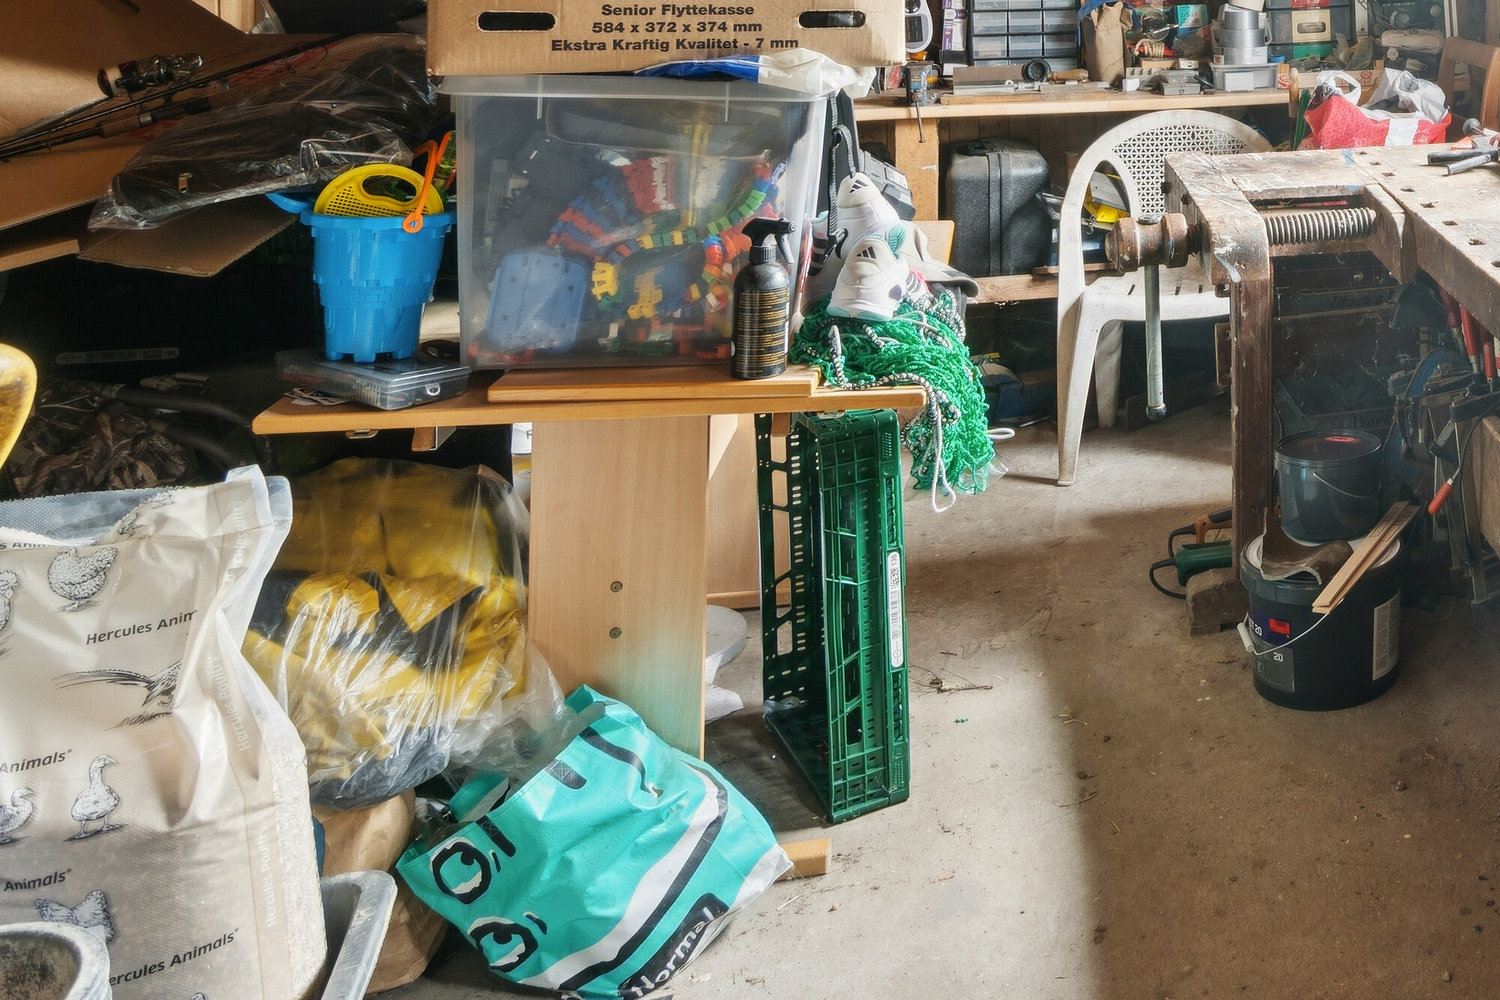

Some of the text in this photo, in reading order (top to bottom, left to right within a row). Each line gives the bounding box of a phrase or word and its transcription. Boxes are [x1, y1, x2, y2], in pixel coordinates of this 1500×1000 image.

[601, 3, 755, 19] Senior Flyttekasse
[592, 21, 763, 34] 584 x 372 x 374 mm
[551, 39, 607, 51] Ekstra
[612, 38, 670, 53] Kraftig
[675, 38, 739, 51] Kvalitet
[756, 38, 764, 50] 7
[769, 40, 799, 50] mm
[86, 621, 152, 645] Hercules
[1254, 623, 1263, 637] 20
[1273, 652, 1284, 663] 20
[630, 906, 719, 999] Normal
